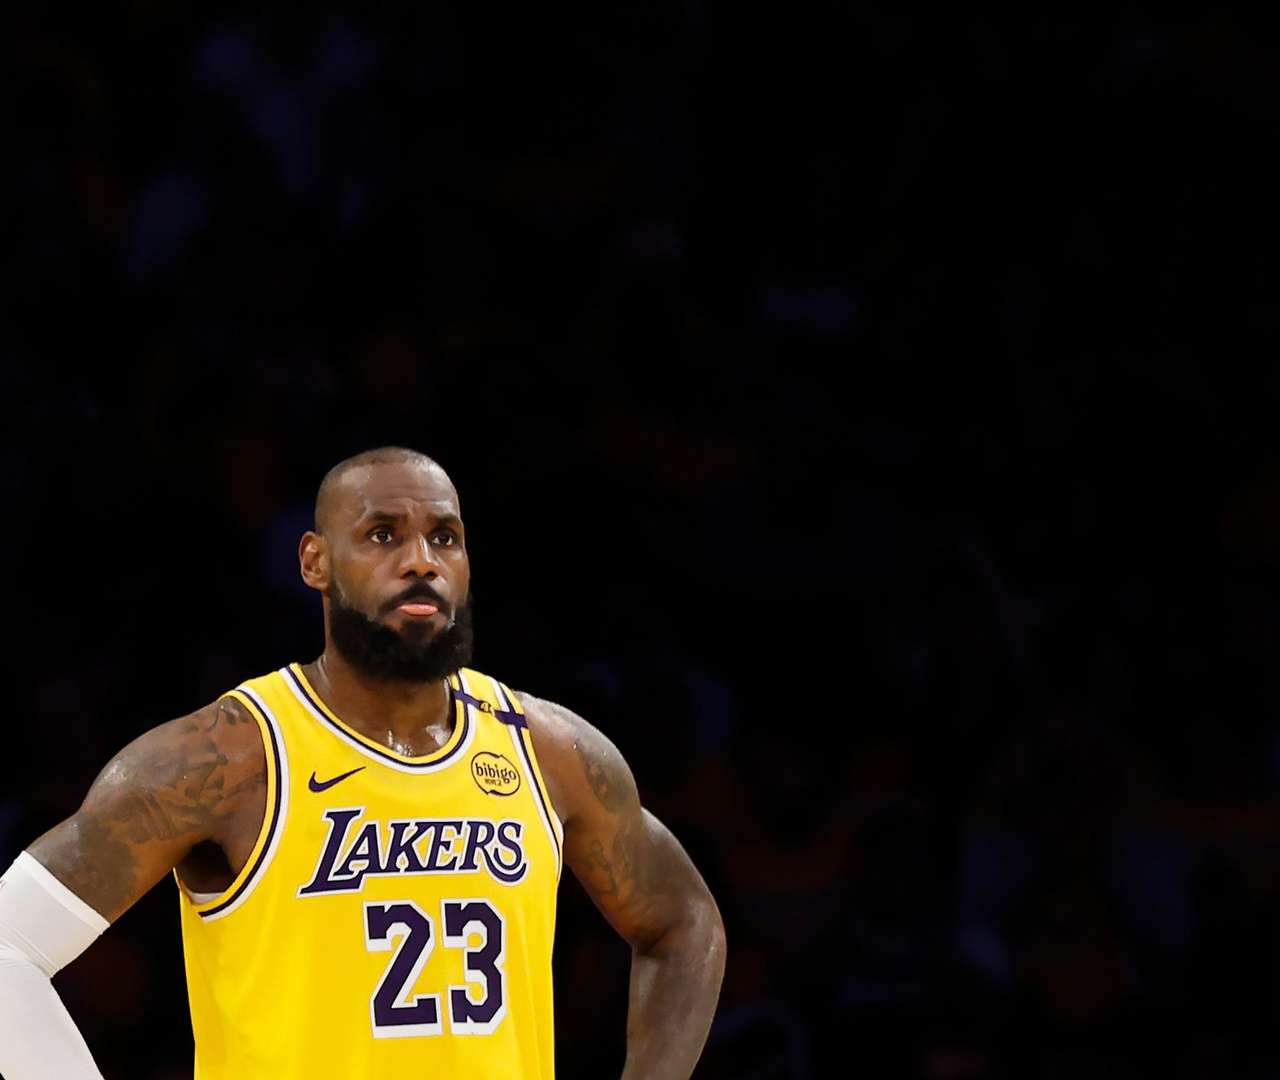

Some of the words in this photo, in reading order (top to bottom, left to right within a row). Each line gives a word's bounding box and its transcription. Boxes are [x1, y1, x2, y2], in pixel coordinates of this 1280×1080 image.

[475, 762, 517, 785] bibigo
[296, 806, 529, 899] LAKERS
[363, 897, 507, 1039] 23
